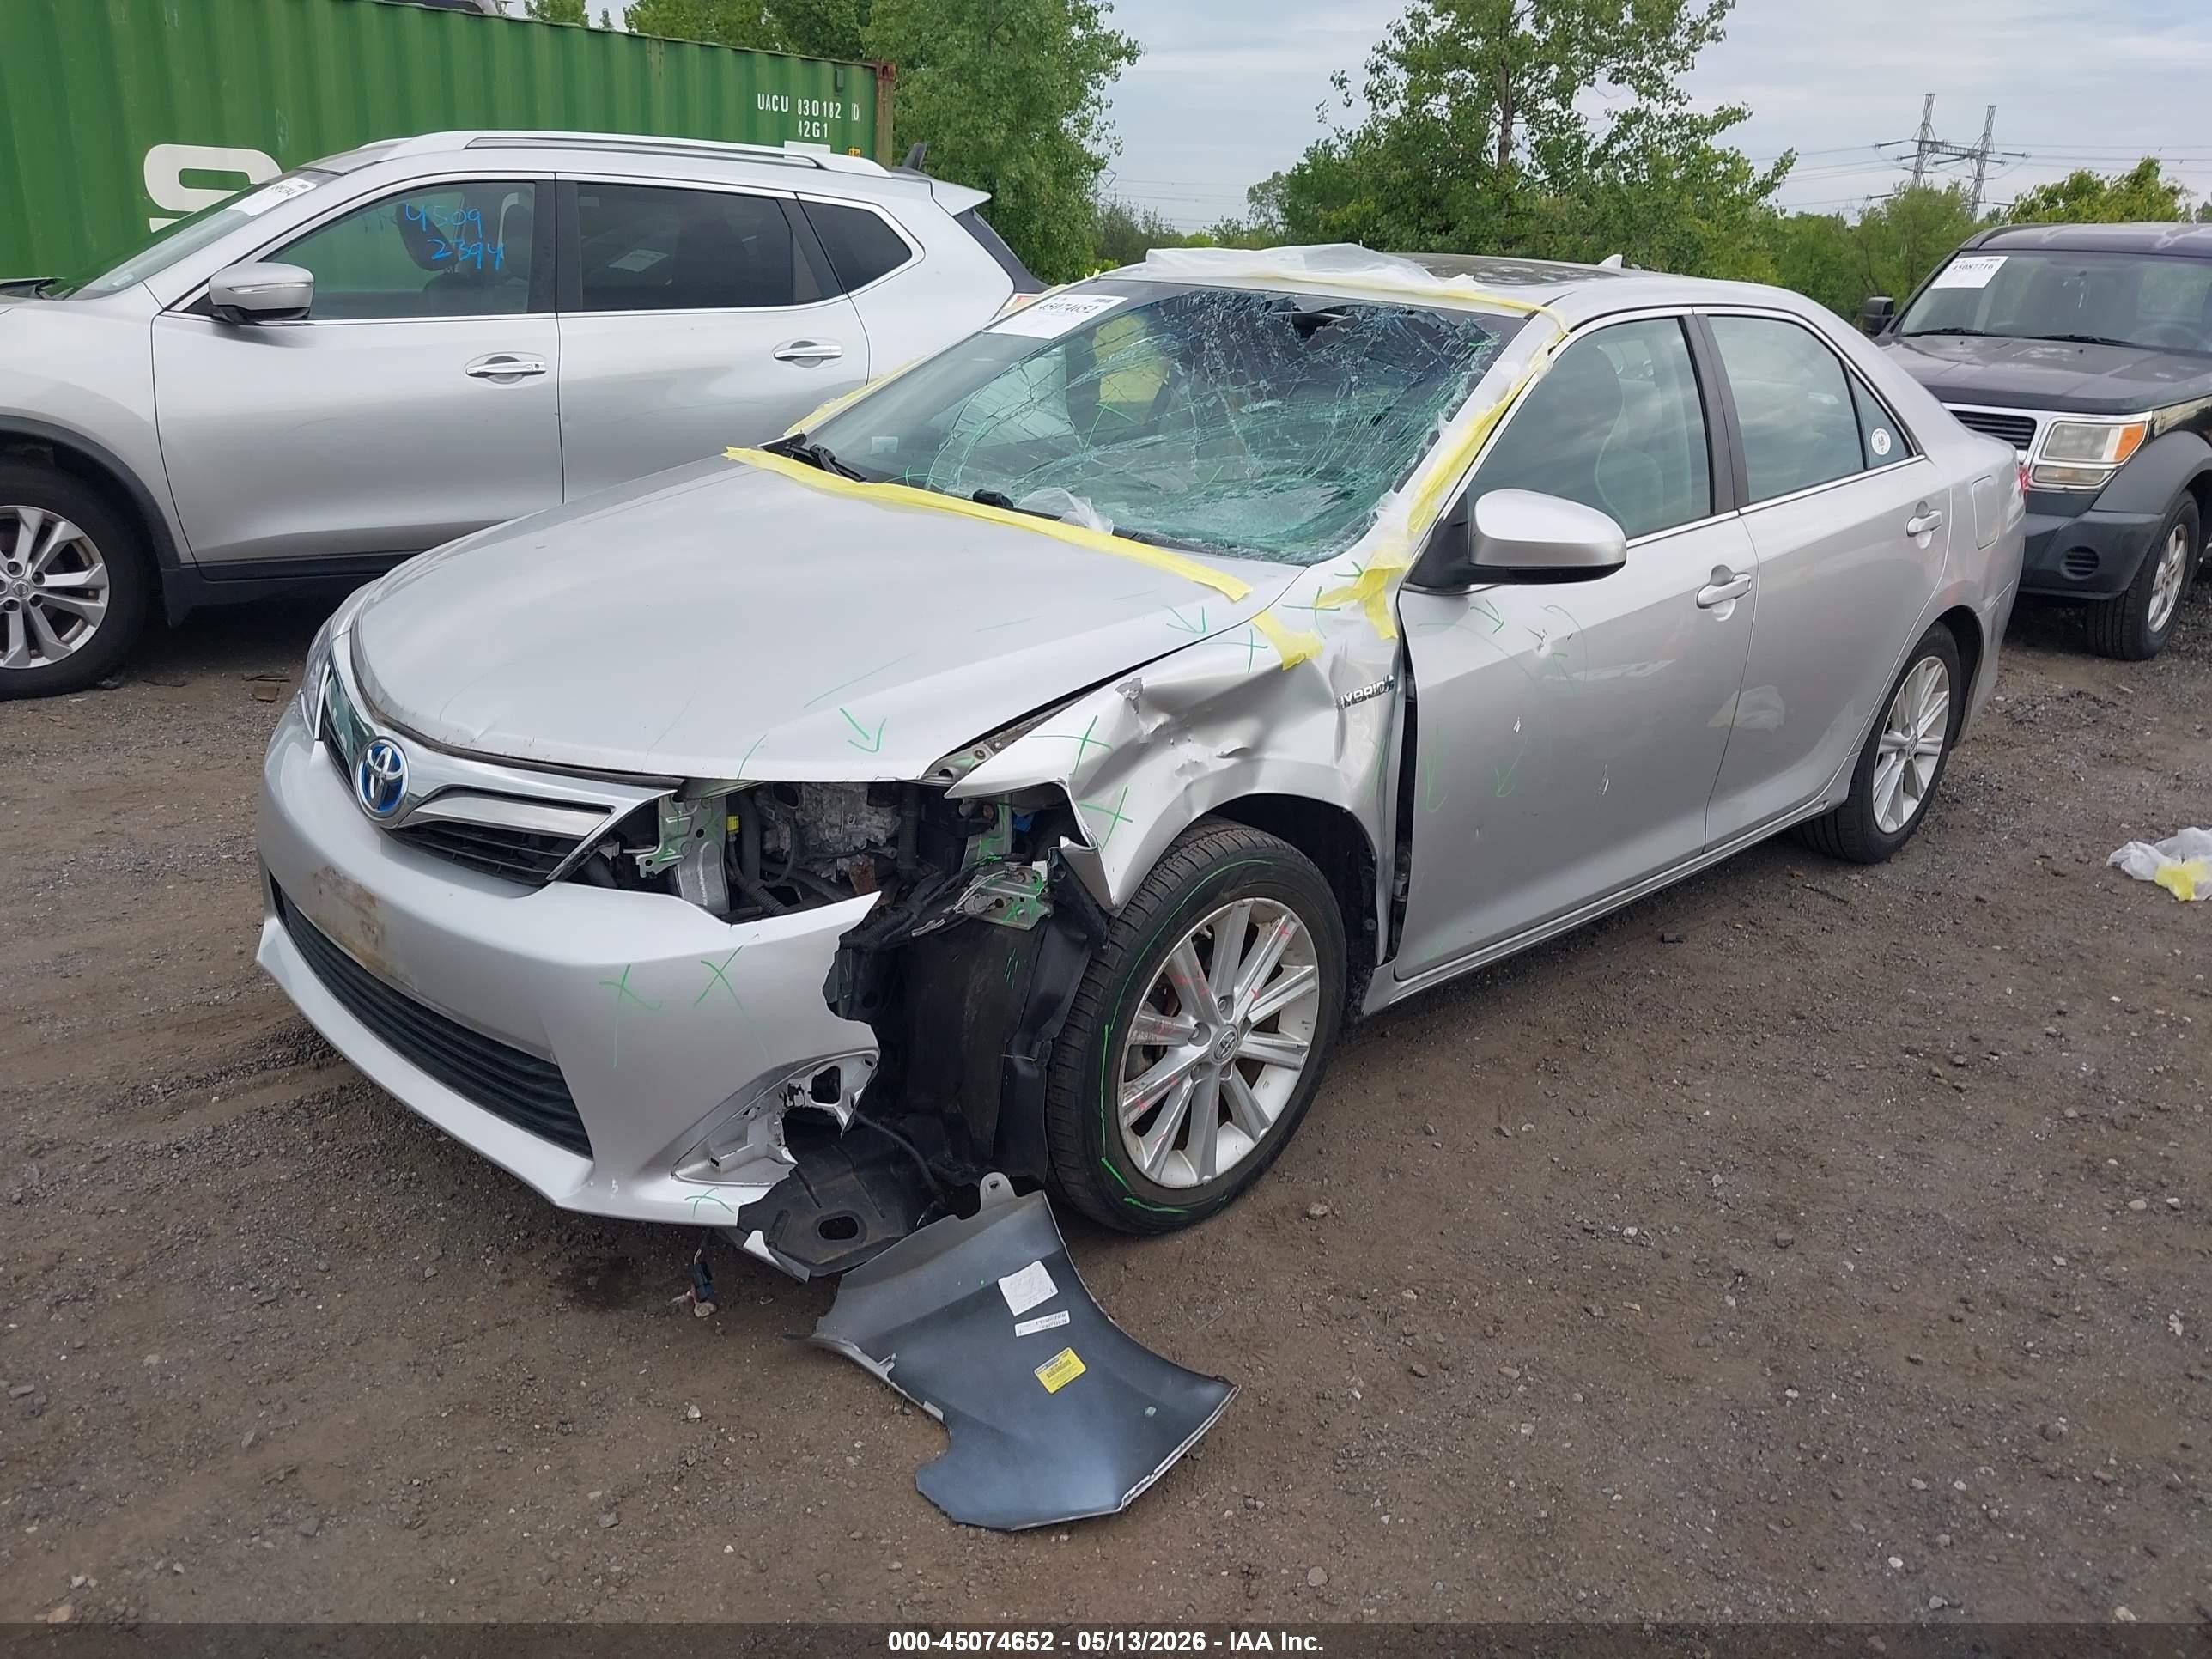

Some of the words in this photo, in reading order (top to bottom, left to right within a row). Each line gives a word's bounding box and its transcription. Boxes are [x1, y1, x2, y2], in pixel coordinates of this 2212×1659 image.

[757, 93, 789, 112] UACU
[797, 98, 842, 119] 830182
[798, 120, 829, 139] 42G1
[404, 203, 483, 239] 4509
[427, 238, 505, 270] 2394
